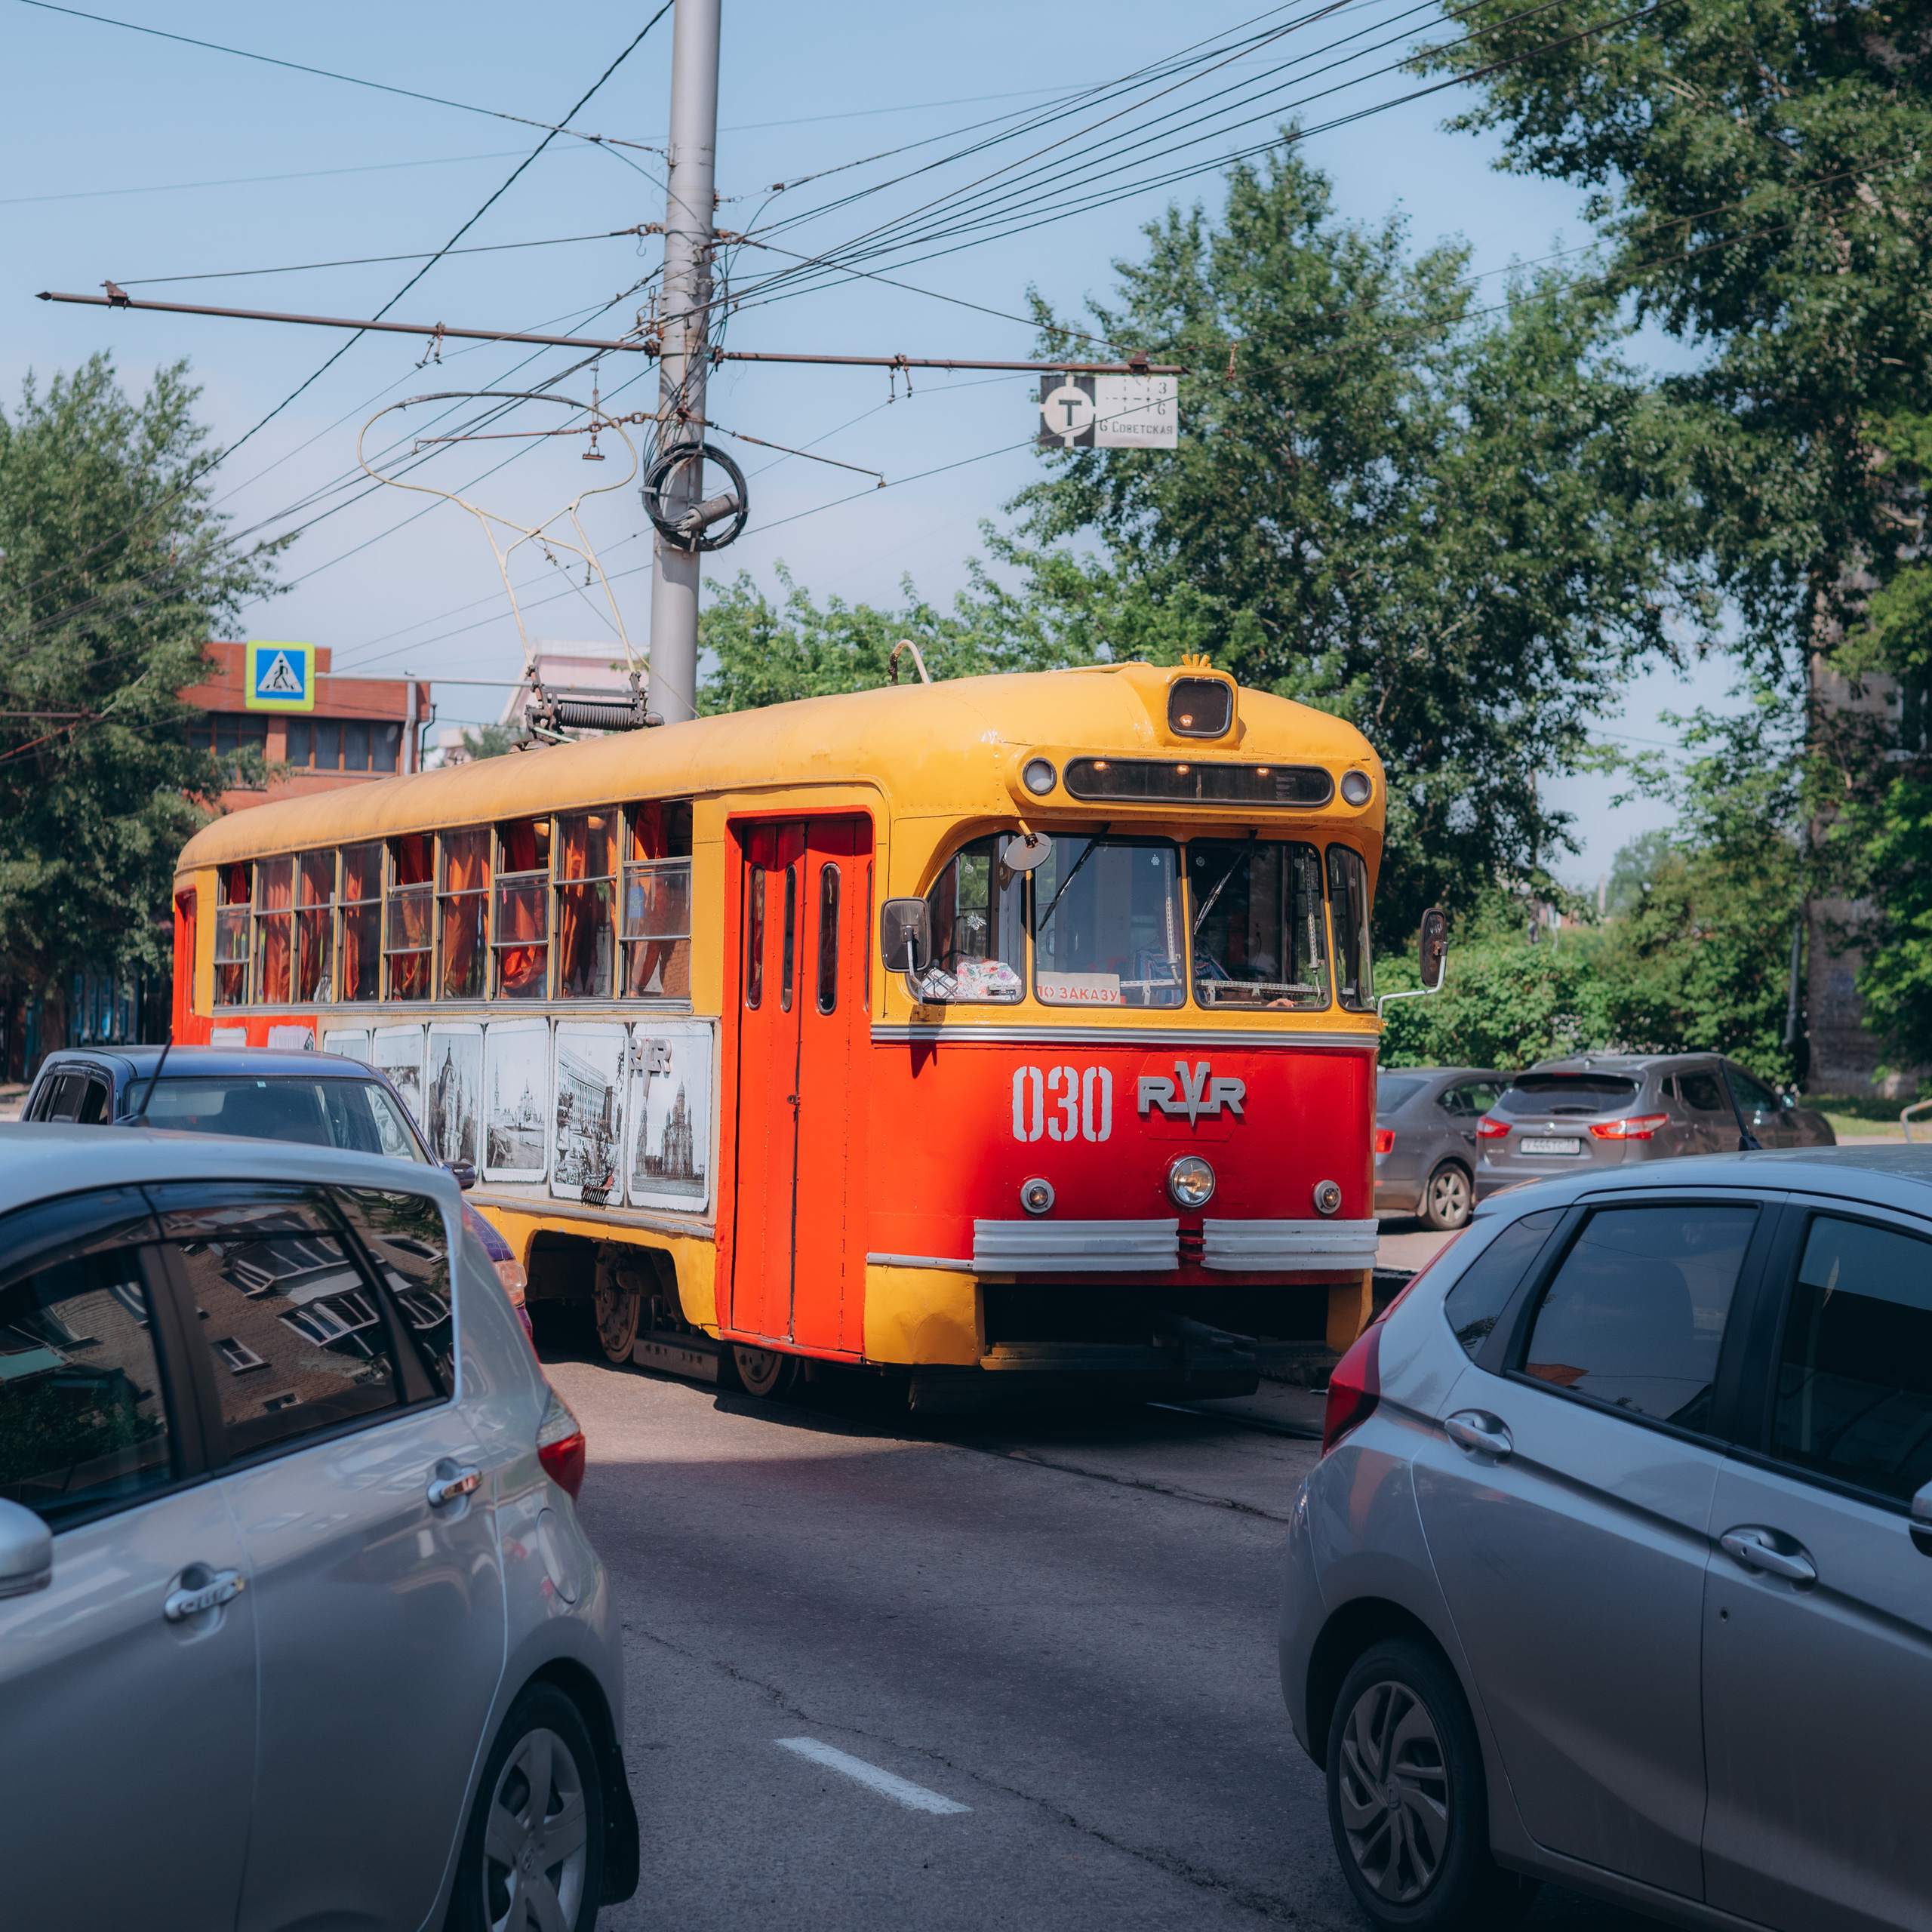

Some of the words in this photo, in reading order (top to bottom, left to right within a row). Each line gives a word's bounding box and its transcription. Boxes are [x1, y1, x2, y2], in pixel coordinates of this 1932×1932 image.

[1158, 381, 1168, 395] 3
[1058, 399, 1082, 426] Т
[1059, 986, 1118, 1002] ЗАКАЗУ
[1012, 1066, 1113, 1143] 030
[1137, 1060, 1246, 1128] RVR
